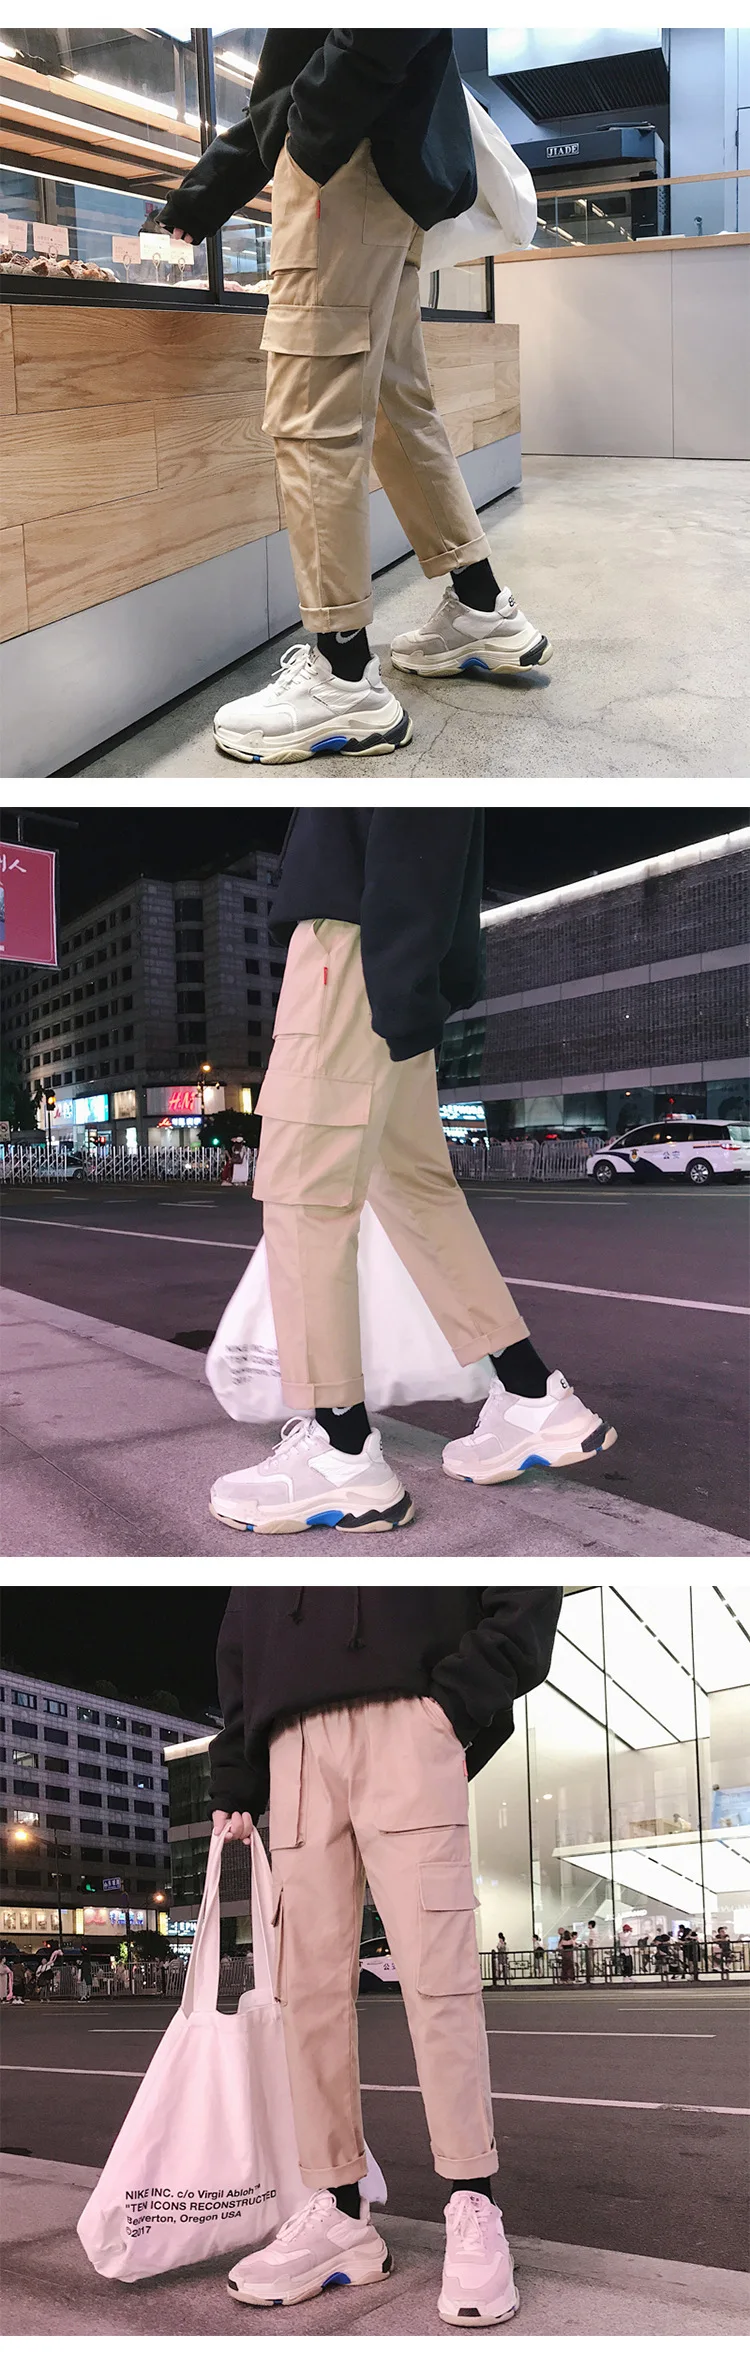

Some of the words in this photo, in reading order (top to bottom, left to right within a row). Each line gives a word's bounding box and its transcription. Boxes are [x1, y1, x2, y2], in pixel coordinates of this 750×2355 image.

[548, 145, 577, 156] JIADE
[125, 2188, 150, 2200] NIKE
[151, 2187, 174, 2198] INC.
[177, 2189, 195, 2199] c/o
[197, 2189, 224, 2201] Virgil
[150, 2200, 187, 2211] ICONS
[189, 2189, 277, 2211] RECONSTRUCTED
[179, 2213, 218, 2224] Oregon
[220, 2210, 242, 2220] USA
